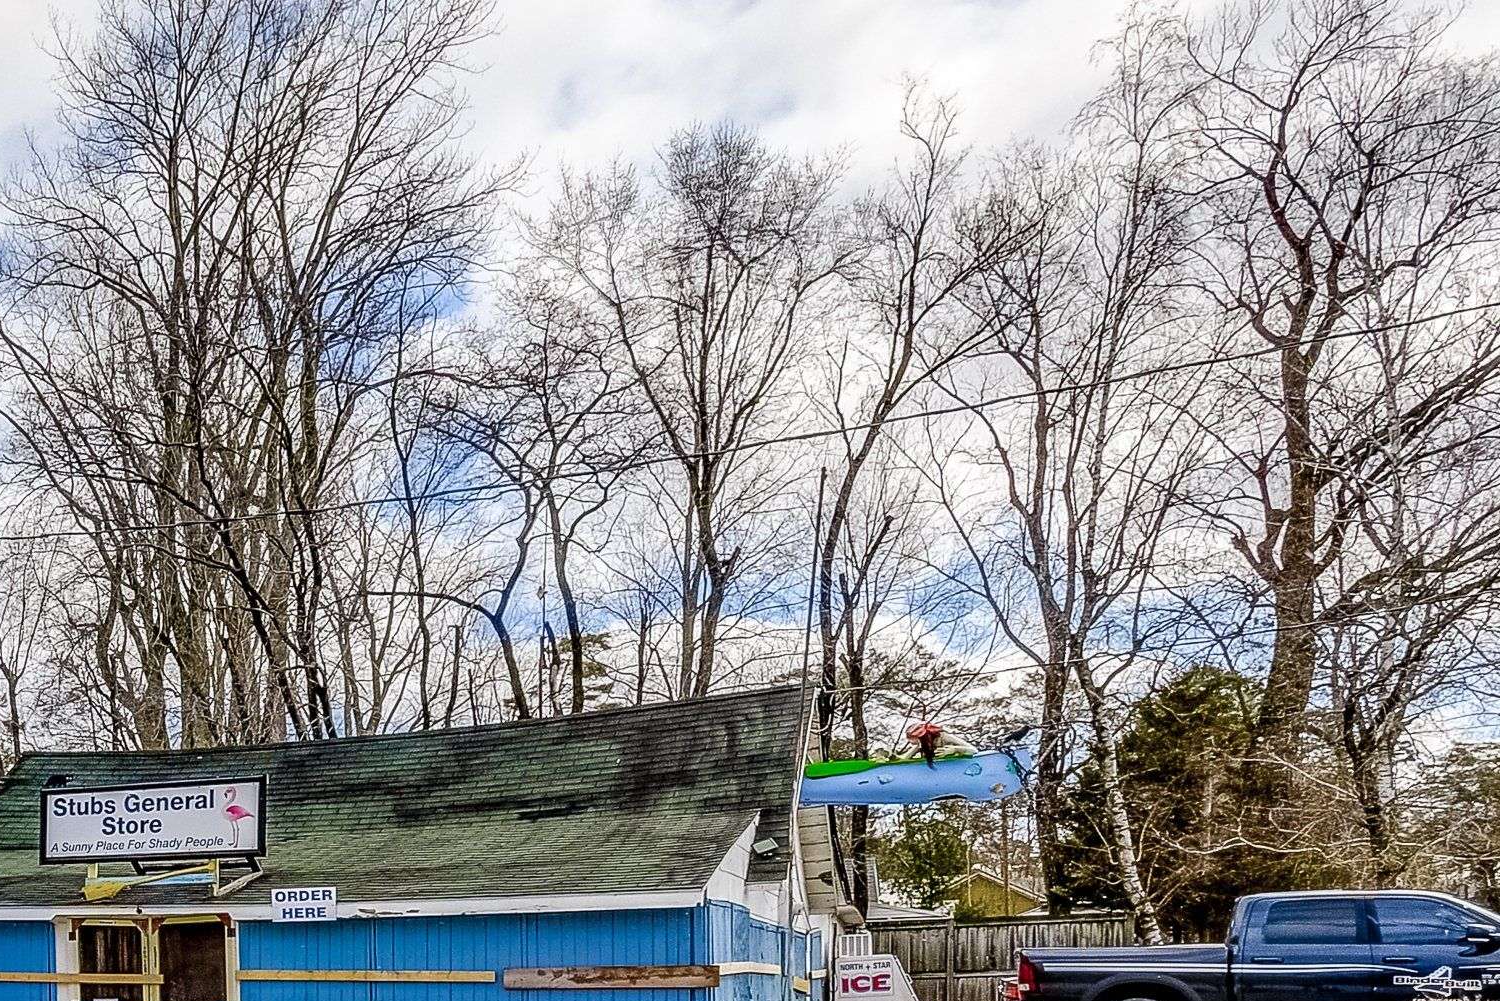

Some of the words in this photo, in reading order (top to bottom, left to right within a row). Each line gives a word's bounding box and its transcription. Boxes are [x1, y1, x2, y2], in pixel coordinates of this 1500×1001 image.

[53, 796, 116, 817] Stubs
[124, 789, 214, 813] General
[102, 816, 162, 835] Store
[50, 842, 59, 853] A
[61, 841, 93, 854] Sunny
[96, 840, 125, 851] Place
[127, 839, 146, 850] For
[148, 837, 182, 850] Shady
[185, 836, 224, 848] People
[274, 889, 333, 902] ORDER
[282, 906, 327, 919] HERE
[841, 973, 892, 993] ICE
